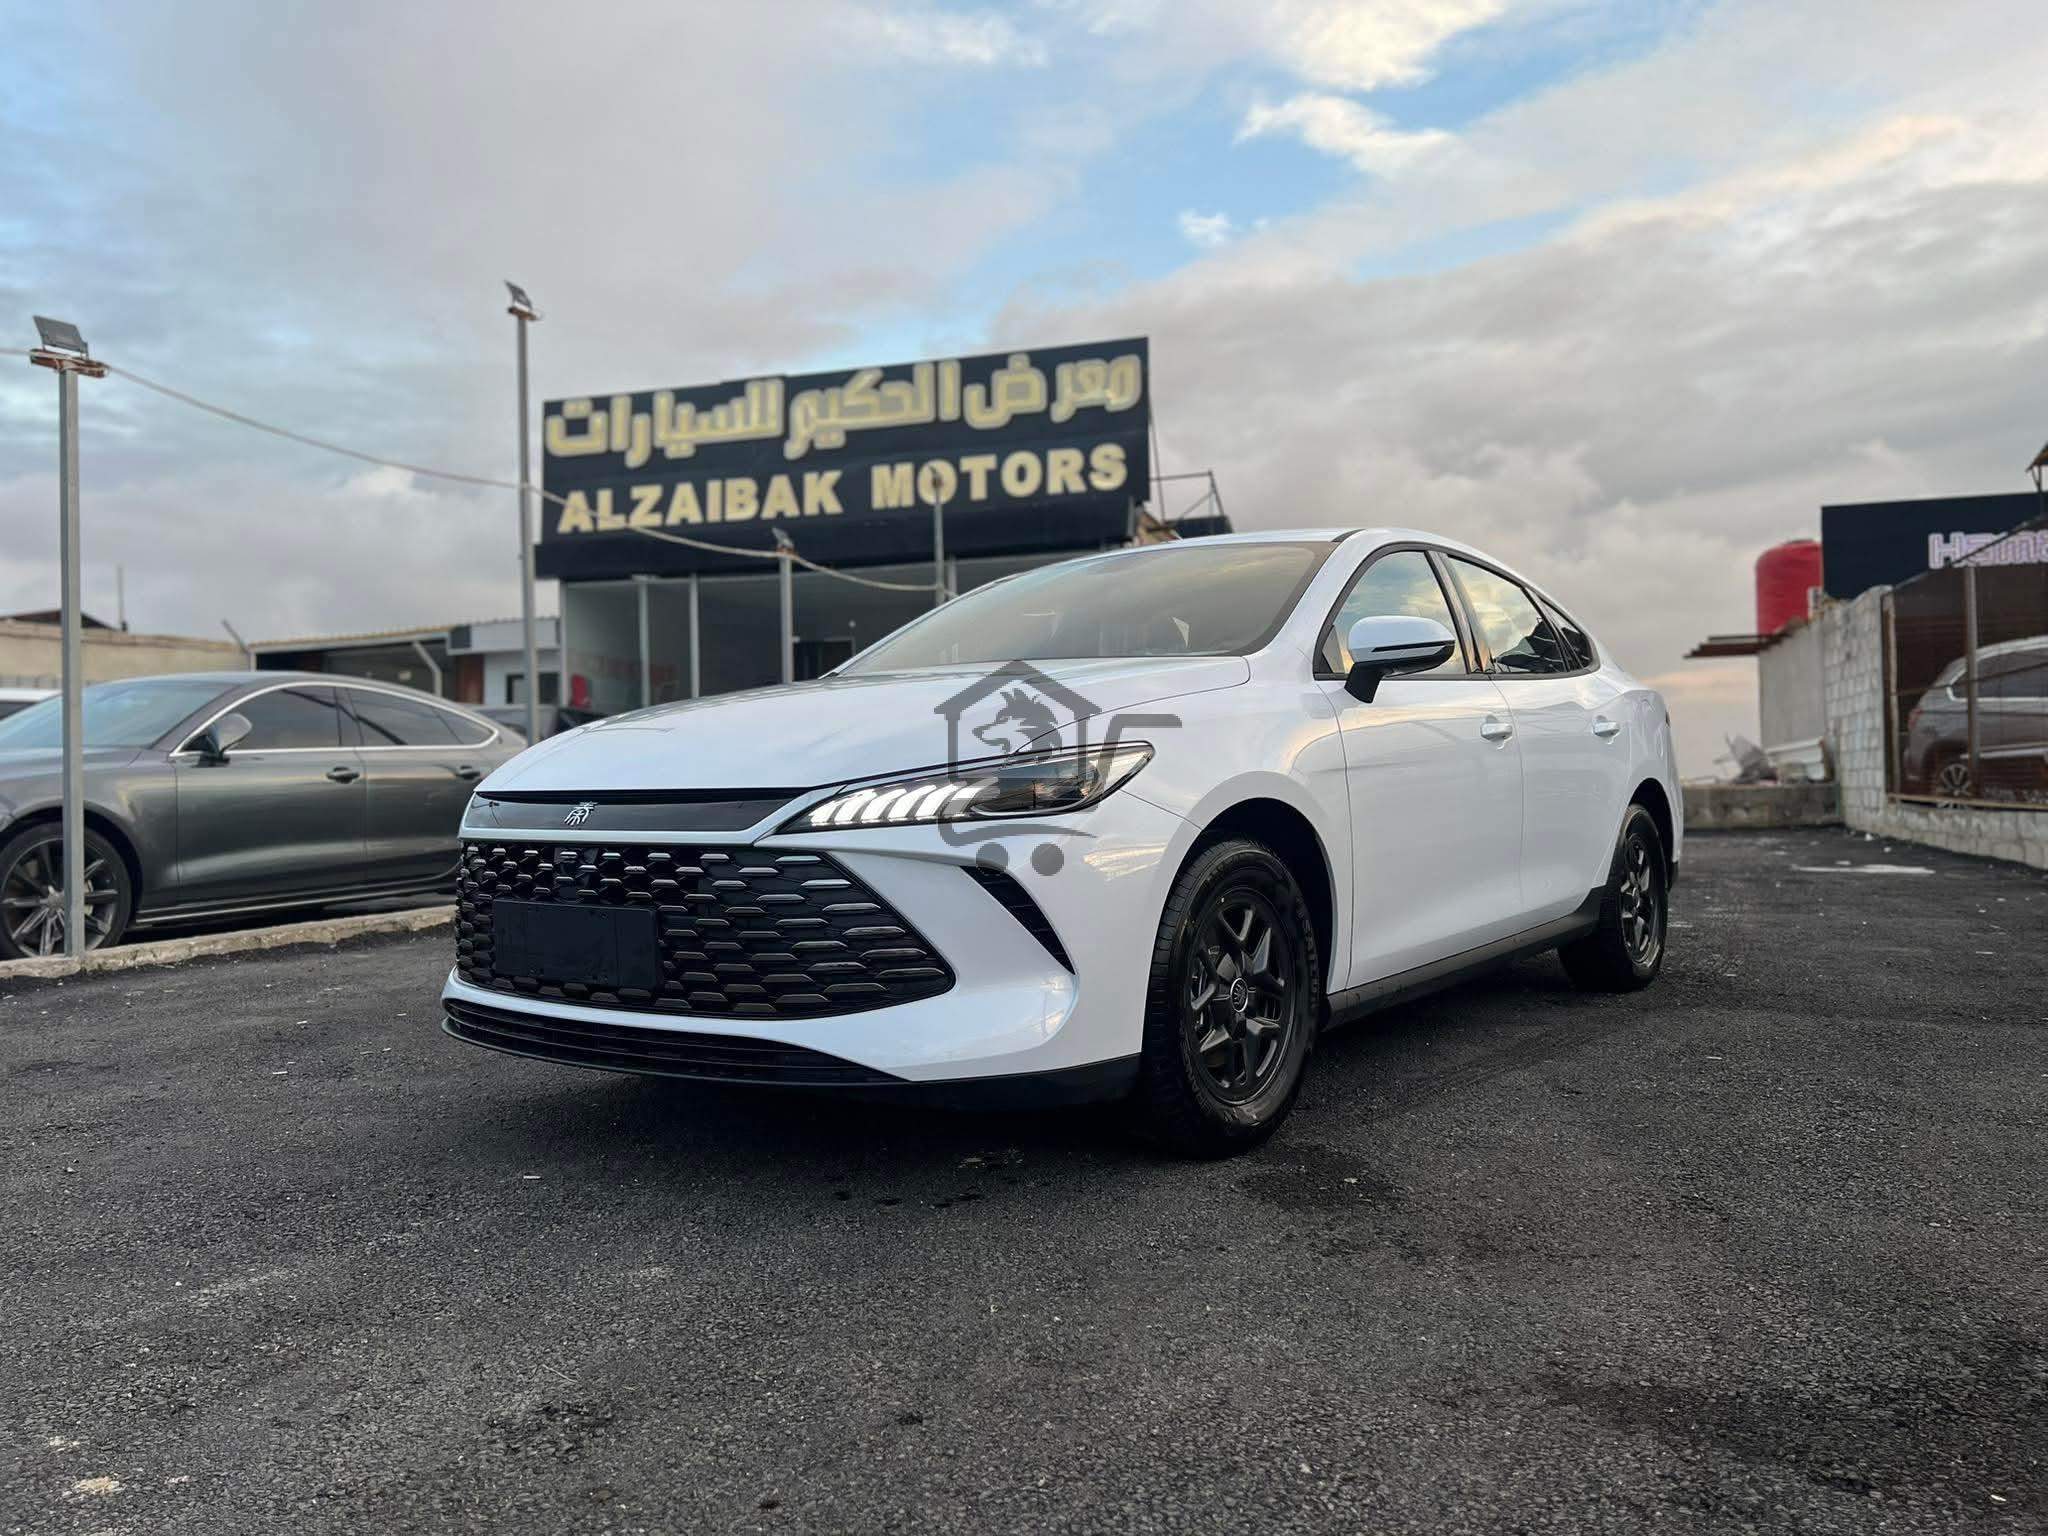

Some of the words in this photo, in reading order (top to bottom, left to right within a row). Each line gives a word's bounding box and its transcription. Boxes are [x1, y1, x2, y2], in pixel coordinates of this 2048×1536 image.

[546, 378, 784, 468] للسيارات
[783, 358, 962, 460] الحكيم
[963, 352, 1142, 430] معرض
[557, 470, 844, 534] ALZAIBAK
[870, 443, 1128, 510] MOTORS
